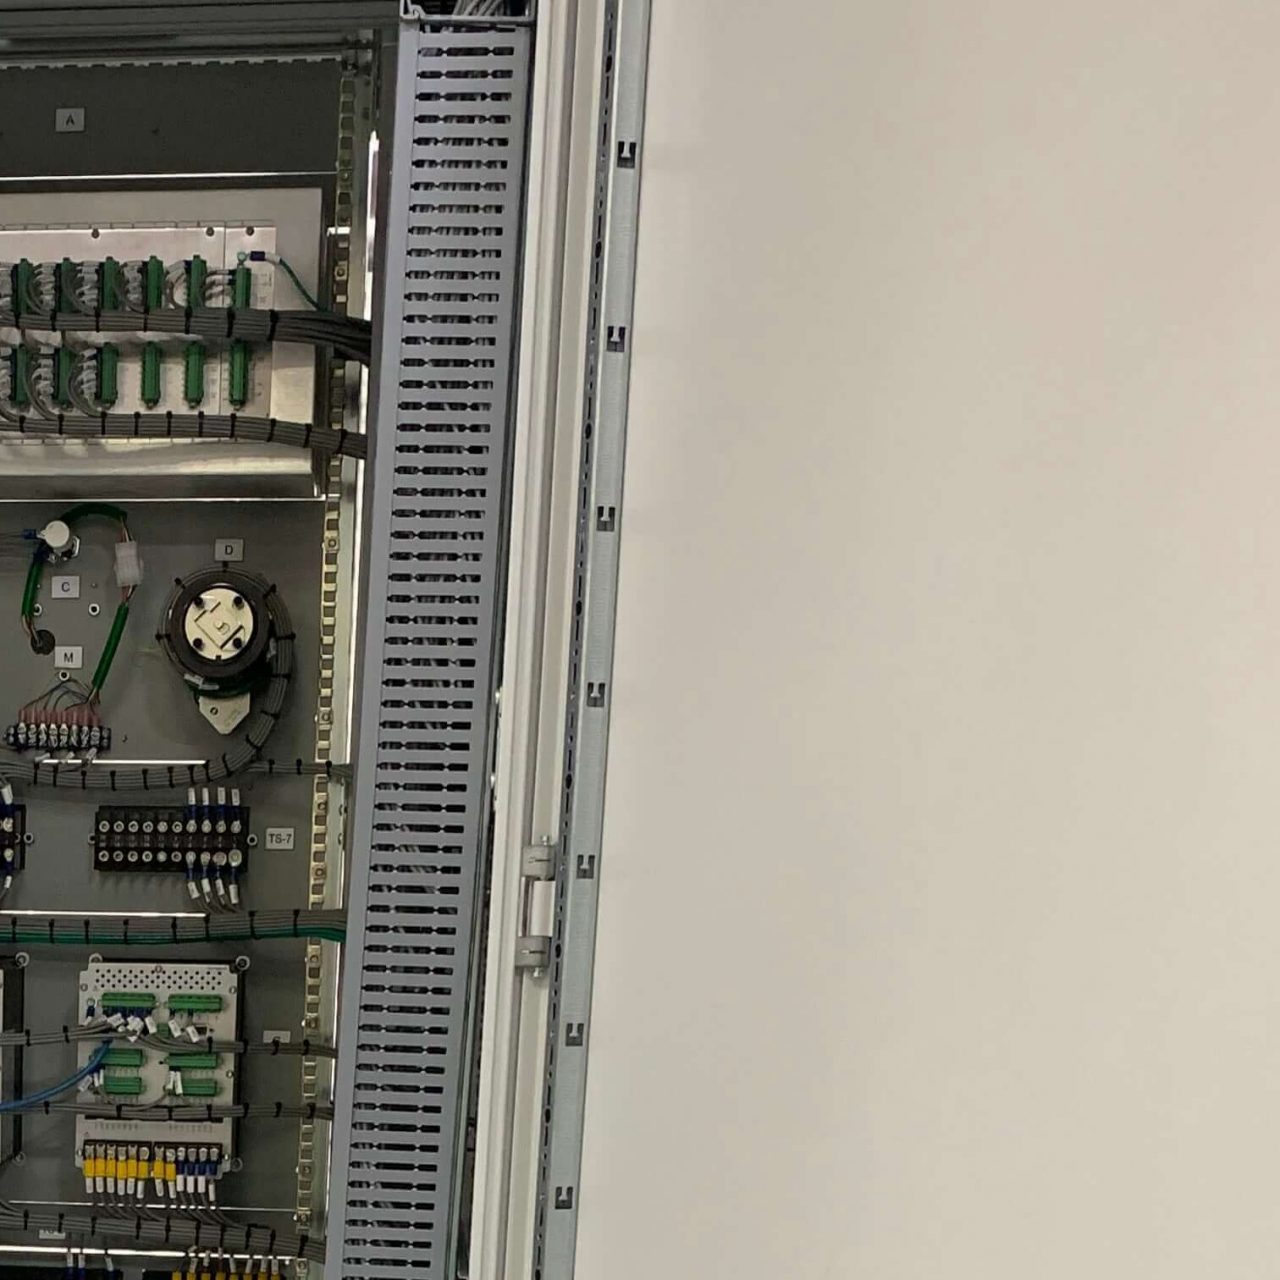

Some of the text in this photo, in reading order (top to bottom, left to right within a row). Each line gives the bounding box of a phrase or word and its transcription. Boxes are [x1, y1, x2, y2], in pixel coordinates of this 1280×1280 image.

[65, 113, 75, 126] A
[224, 544, 234, 555] D
[61, 581, 71, 592] C
[63, 652, 74, 663] M
[268, 833, 292, 844] TS-7
